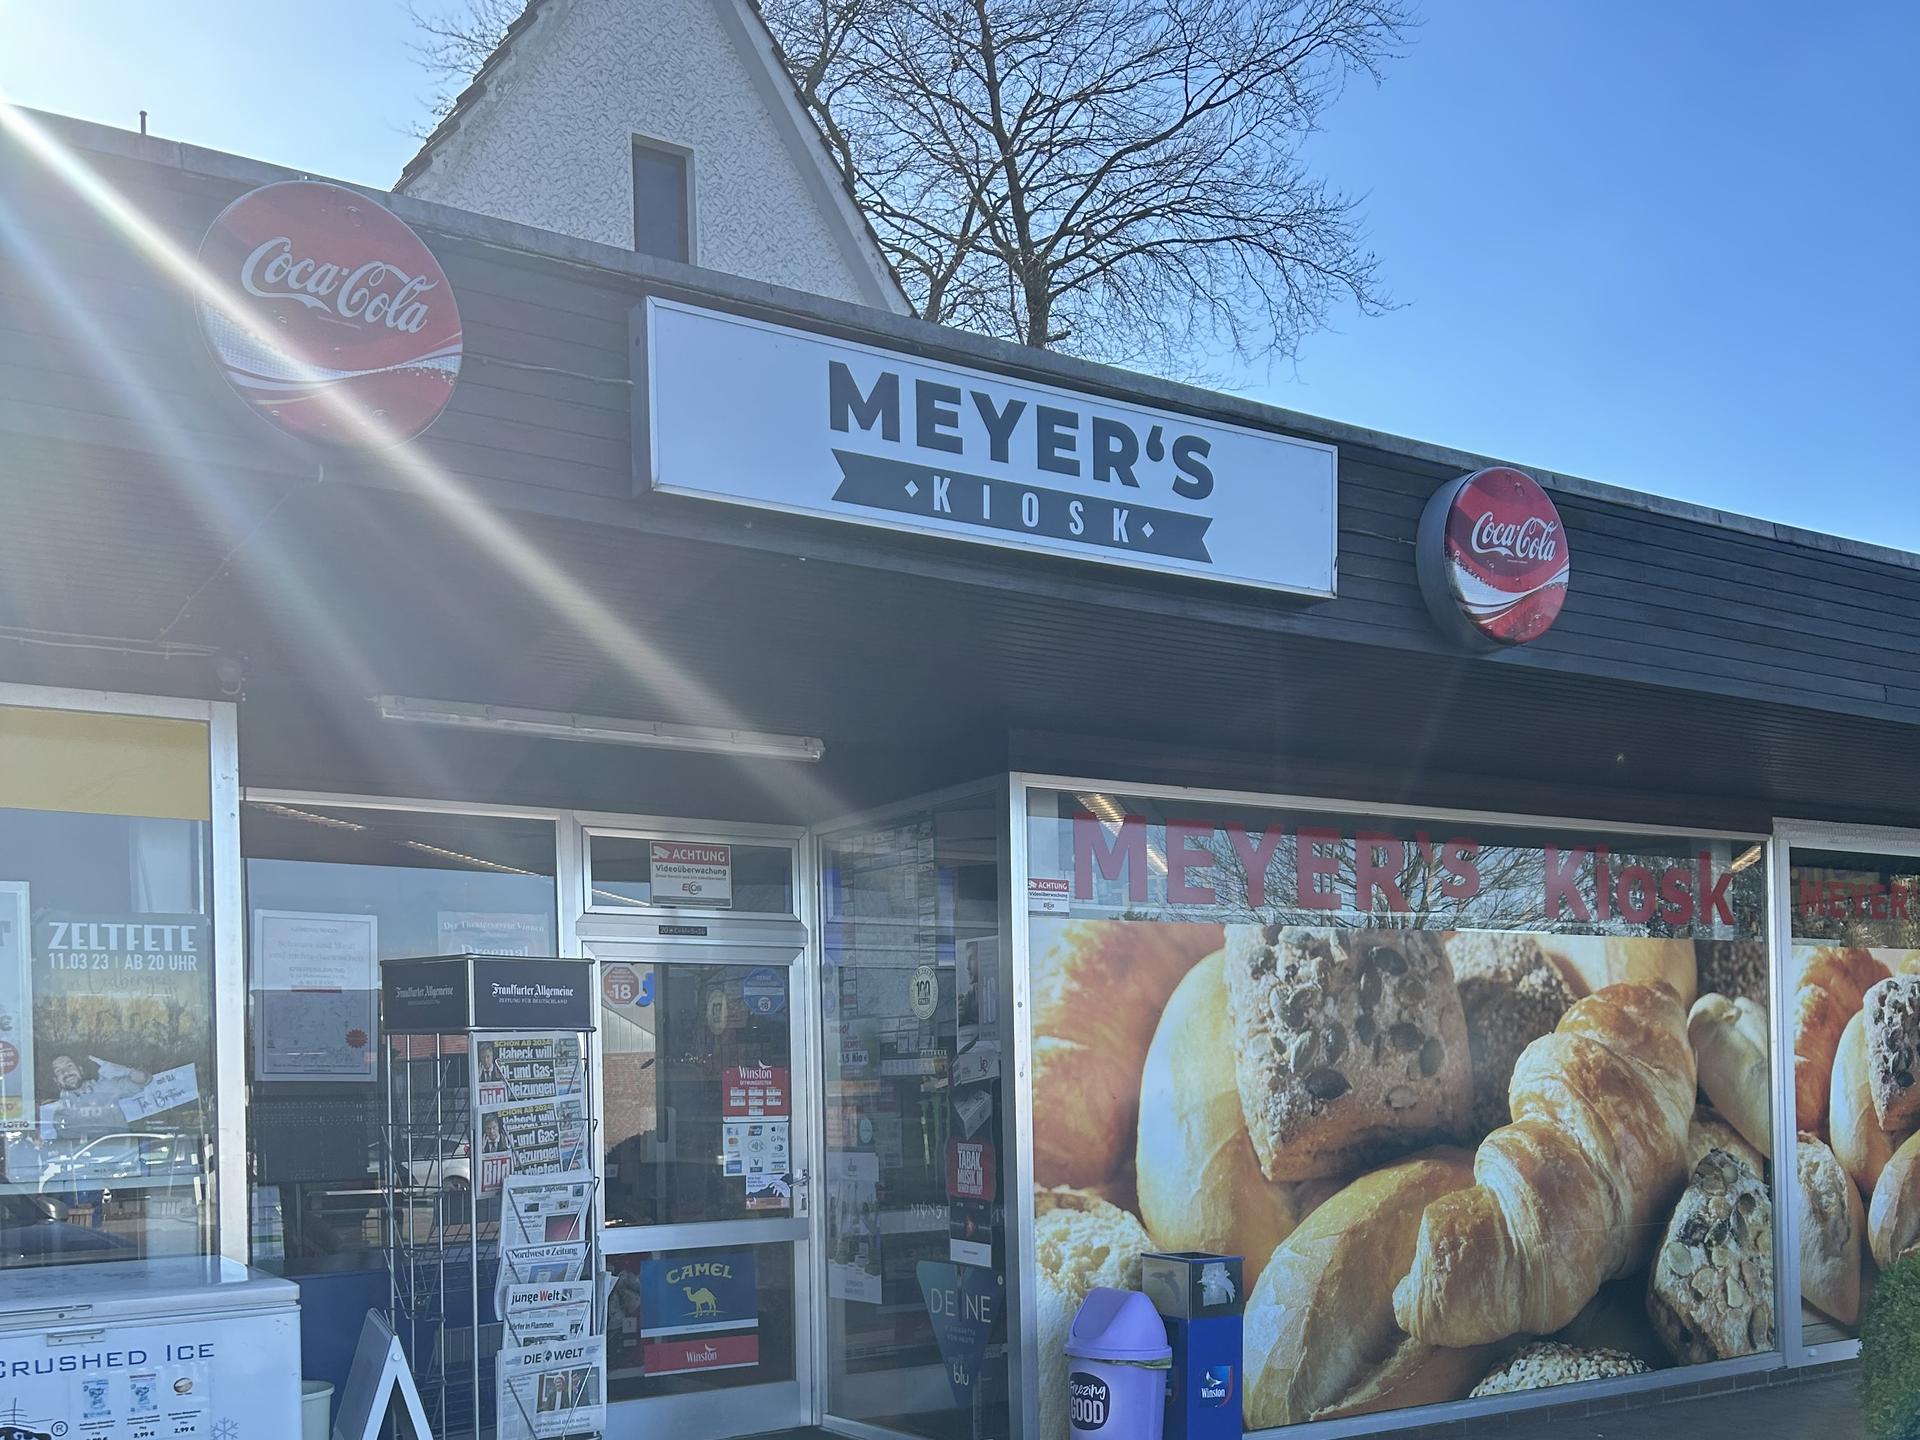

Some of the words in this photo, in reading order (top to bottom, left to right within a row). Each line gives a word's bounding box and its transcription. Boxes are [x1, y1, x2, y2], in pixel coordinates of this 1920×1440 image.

[240, 236, 439, 334] Coca-Cola
[828, 360, 1215, 500] MEYER'S
[933, 475, 1129, 543] KIOSK
[1471, 511, 1558, 561] Coca-Cola
[672, 849, 726, 863] ACHTUNG
[655, 864, 727, 876] Videoüberwachung
[1073, 810, 1482, 913] MEYER'S
[1543, 843, 1736, 927] Kiosk
[1038, 881, 1068, 890] ACHTUNG
[48, 921, 197, 952] ZELTFETE
[91, 954, 109, 970] 23
[124, 955, 143, 970] AB
[147, 955, 164, 970] 20
[169, 955, 197, 971] UHR
[491, 982, 535, 997] Frankfurter
[534, 983, 574, 999] Allgemeine
[612, 983, 632, 999] 18
[494, 1039, 521, 1048] SCHON
[521, 1039, 533, 1047] AB
[499, 1047, 534, 1059] Habeck
[535, 1045, 552, 1058] will
[532, 1063, 554, 1078] Gas-
[738, 1065, 772, 1079] Winston
[497, 1109, 523, 1118] SCHON
[523, 1107, 534, 1115] AB
[537, 1129, 558, 1142] Gas-
[484, 1157, 512, 1192] Bild
[957, 1168, 976, 1185] MUSIK
[511, 1250, 545, 1260] Nordwest
[551, 1247, 578, 1257] Zeitung
[666, 1262, 732, 1284] CAMEL
[531, 1321, 554, 1329] Flammen
[166, 1343, 215, 1361] ICE
[524, 1353, 542, 1365] DIE
[686, 1350, 718, 1363] Winston
[953, 1364, 970, 1386] blu
[1070, 1380, 1106, 1400] Freezing
[1201, 1387, 1226, 1399] Winston
[1070, 1396, 1104, 1424] GOOD
